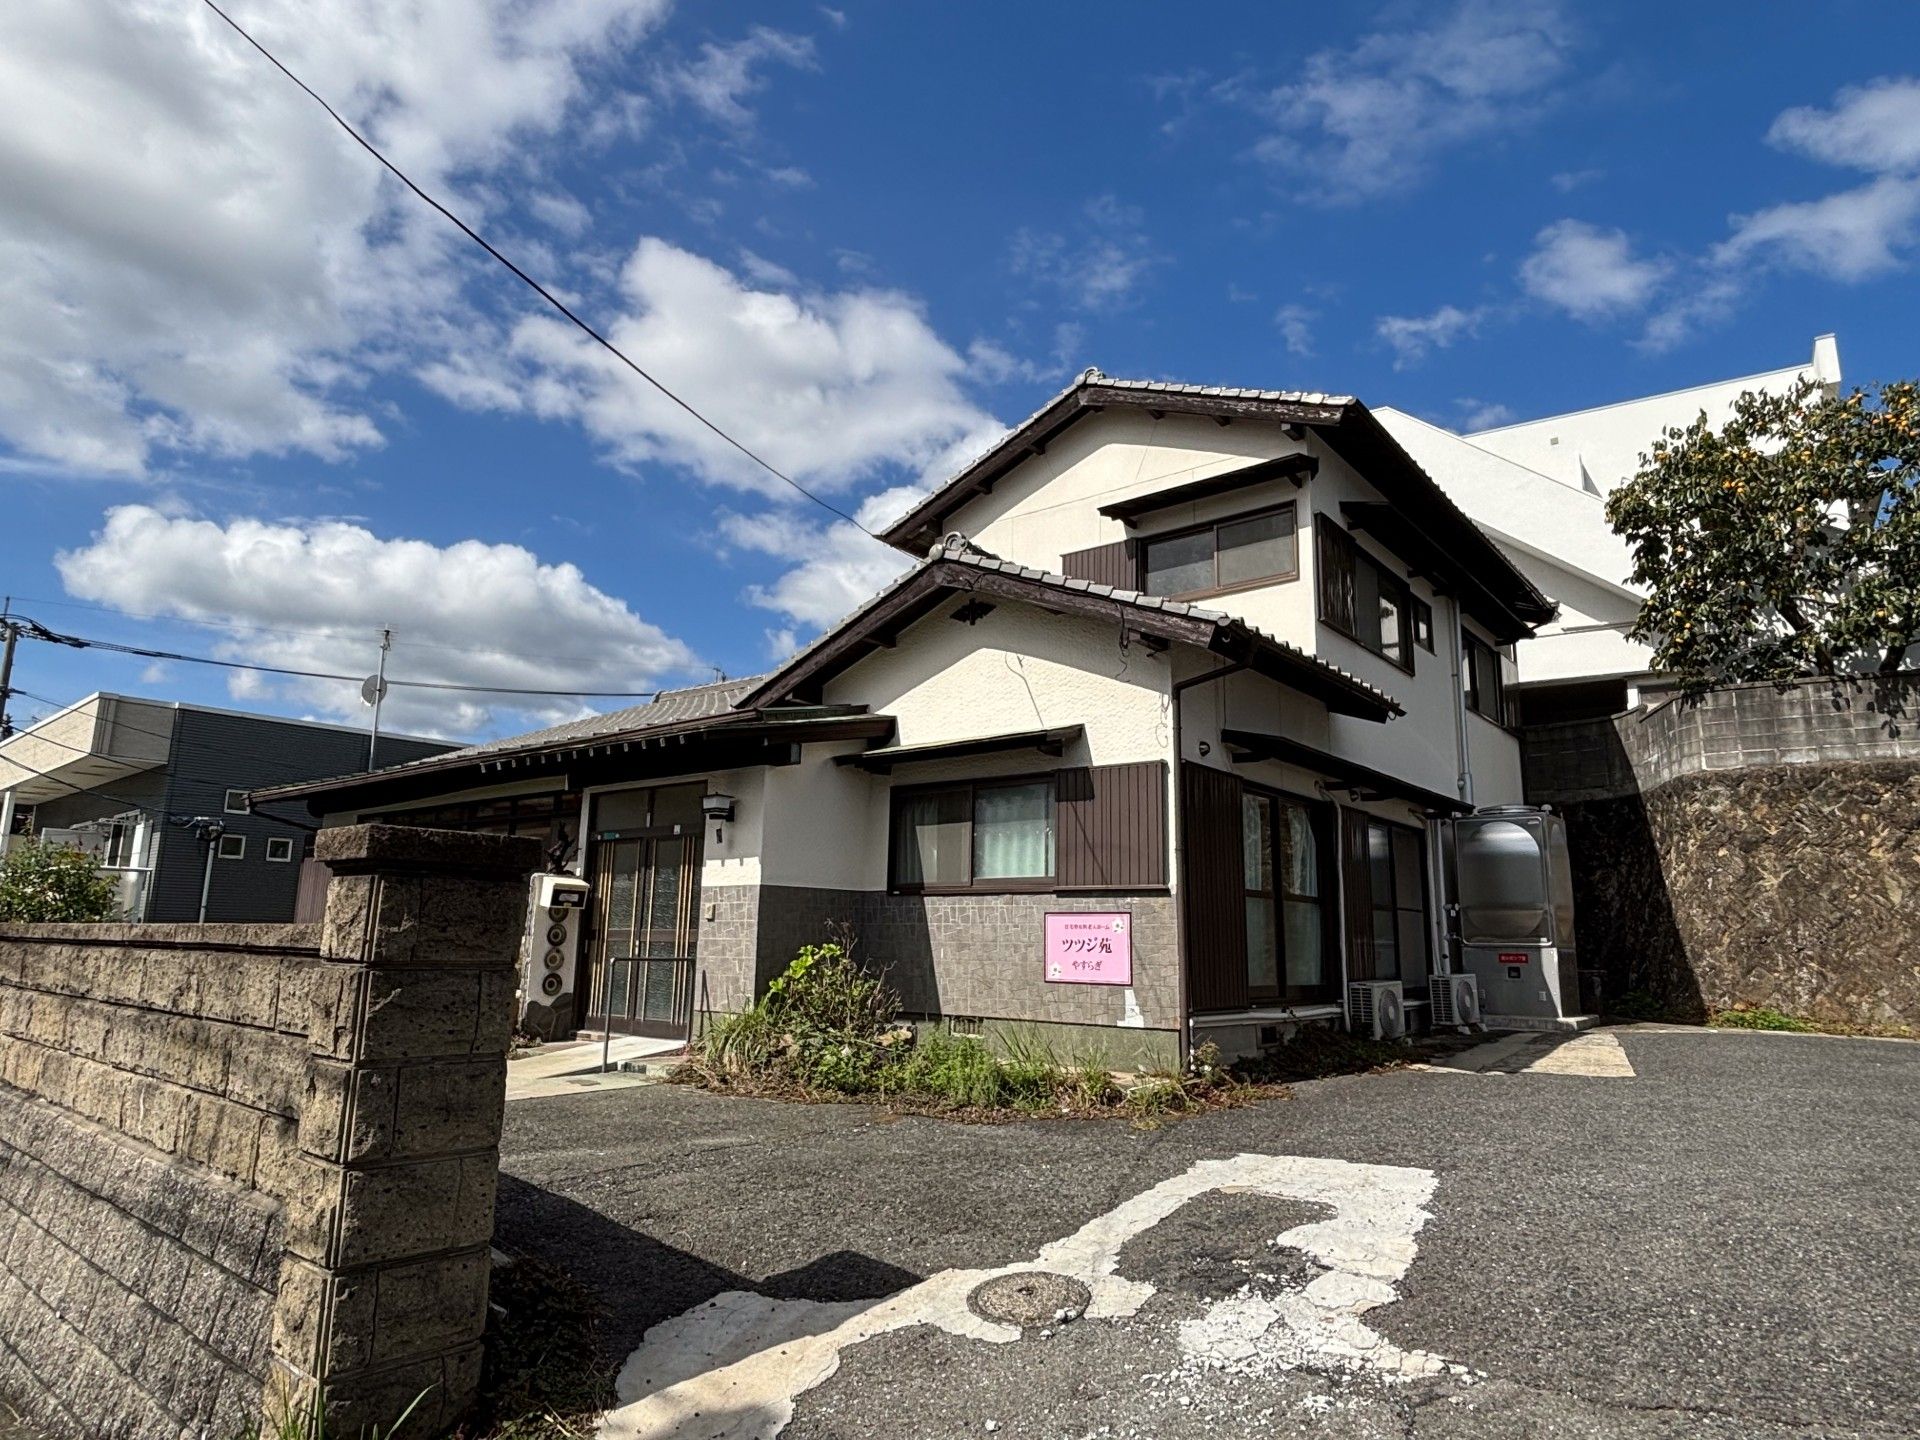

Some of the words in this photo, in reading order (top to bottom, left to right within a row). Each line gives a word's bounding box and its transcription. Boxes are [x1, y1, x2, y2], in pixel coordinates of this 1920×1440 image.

[1062, 937, 1112, 954] ツツジ苑
[1072, 960, 1103, 971] やすらぎ
